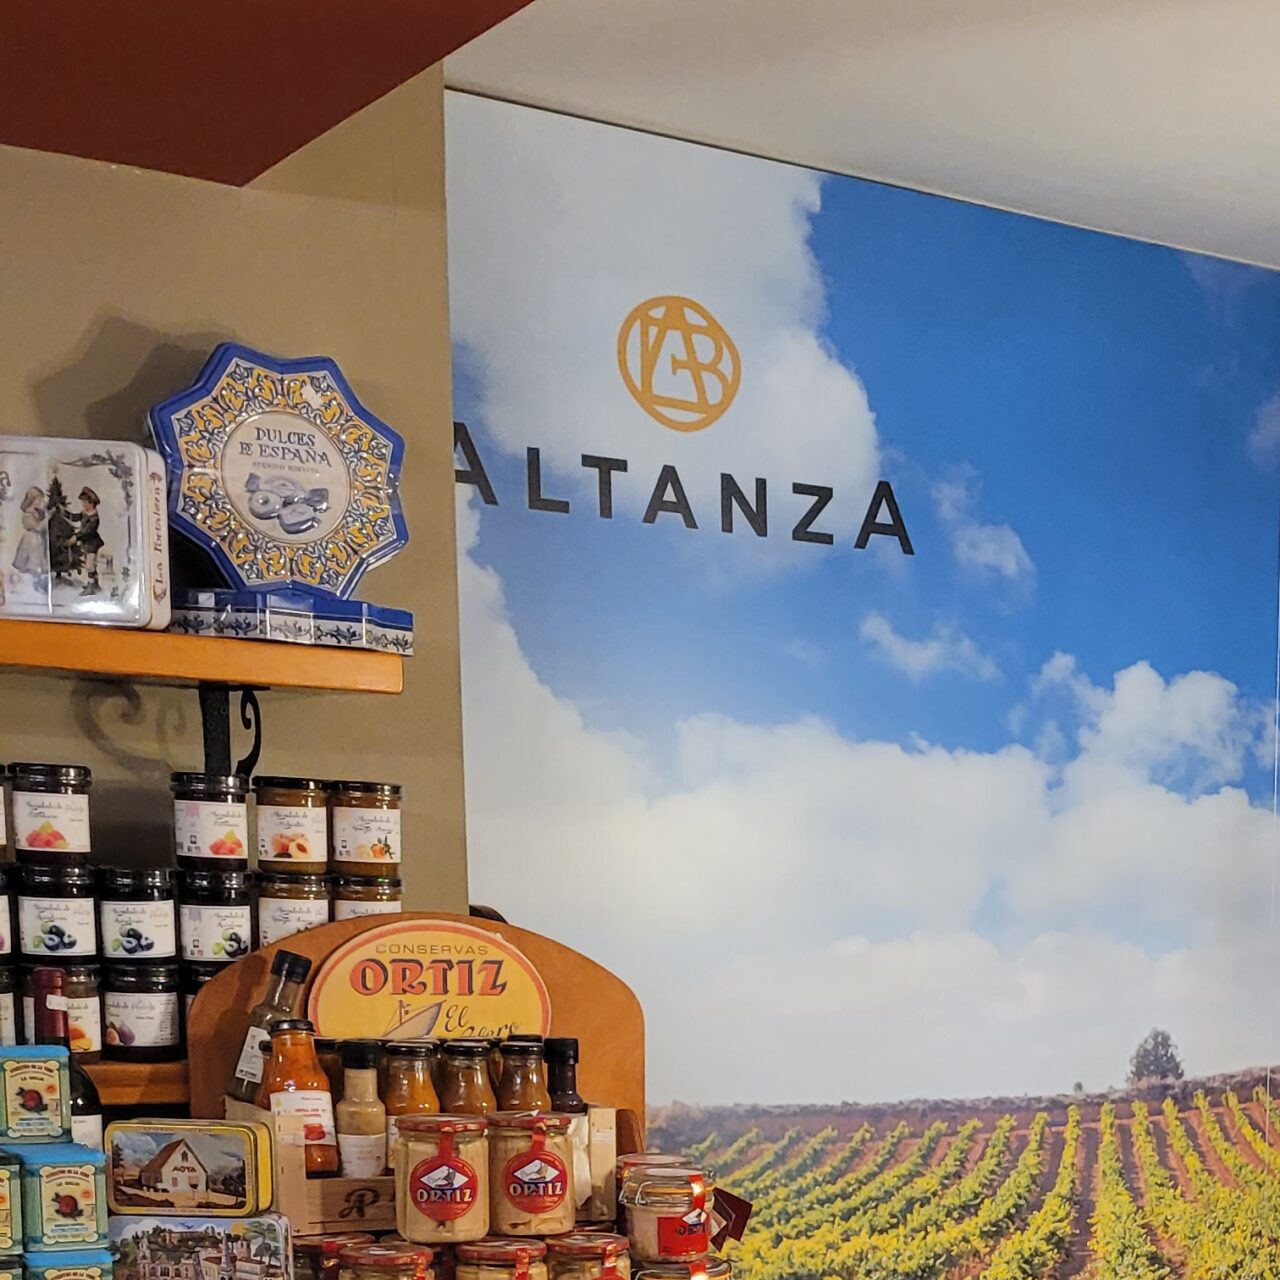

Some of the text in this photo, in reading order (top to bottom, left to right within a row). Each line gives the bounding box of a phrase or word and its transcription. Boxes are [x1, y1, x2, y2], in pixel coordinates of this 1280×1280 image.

[254, 426, 316, 448] DULCES
[258, 443, 333, 469] ESPAÑA
[453, 420, 916, 556] ALTANZA
[374, 943, 489, 957] CONSERVAS
[349, 957, 508, 997] ORTIZ
[416, 1189, 473, 1203] ORTIZ
[509, 1182, 563, 1197] ORTIZ
